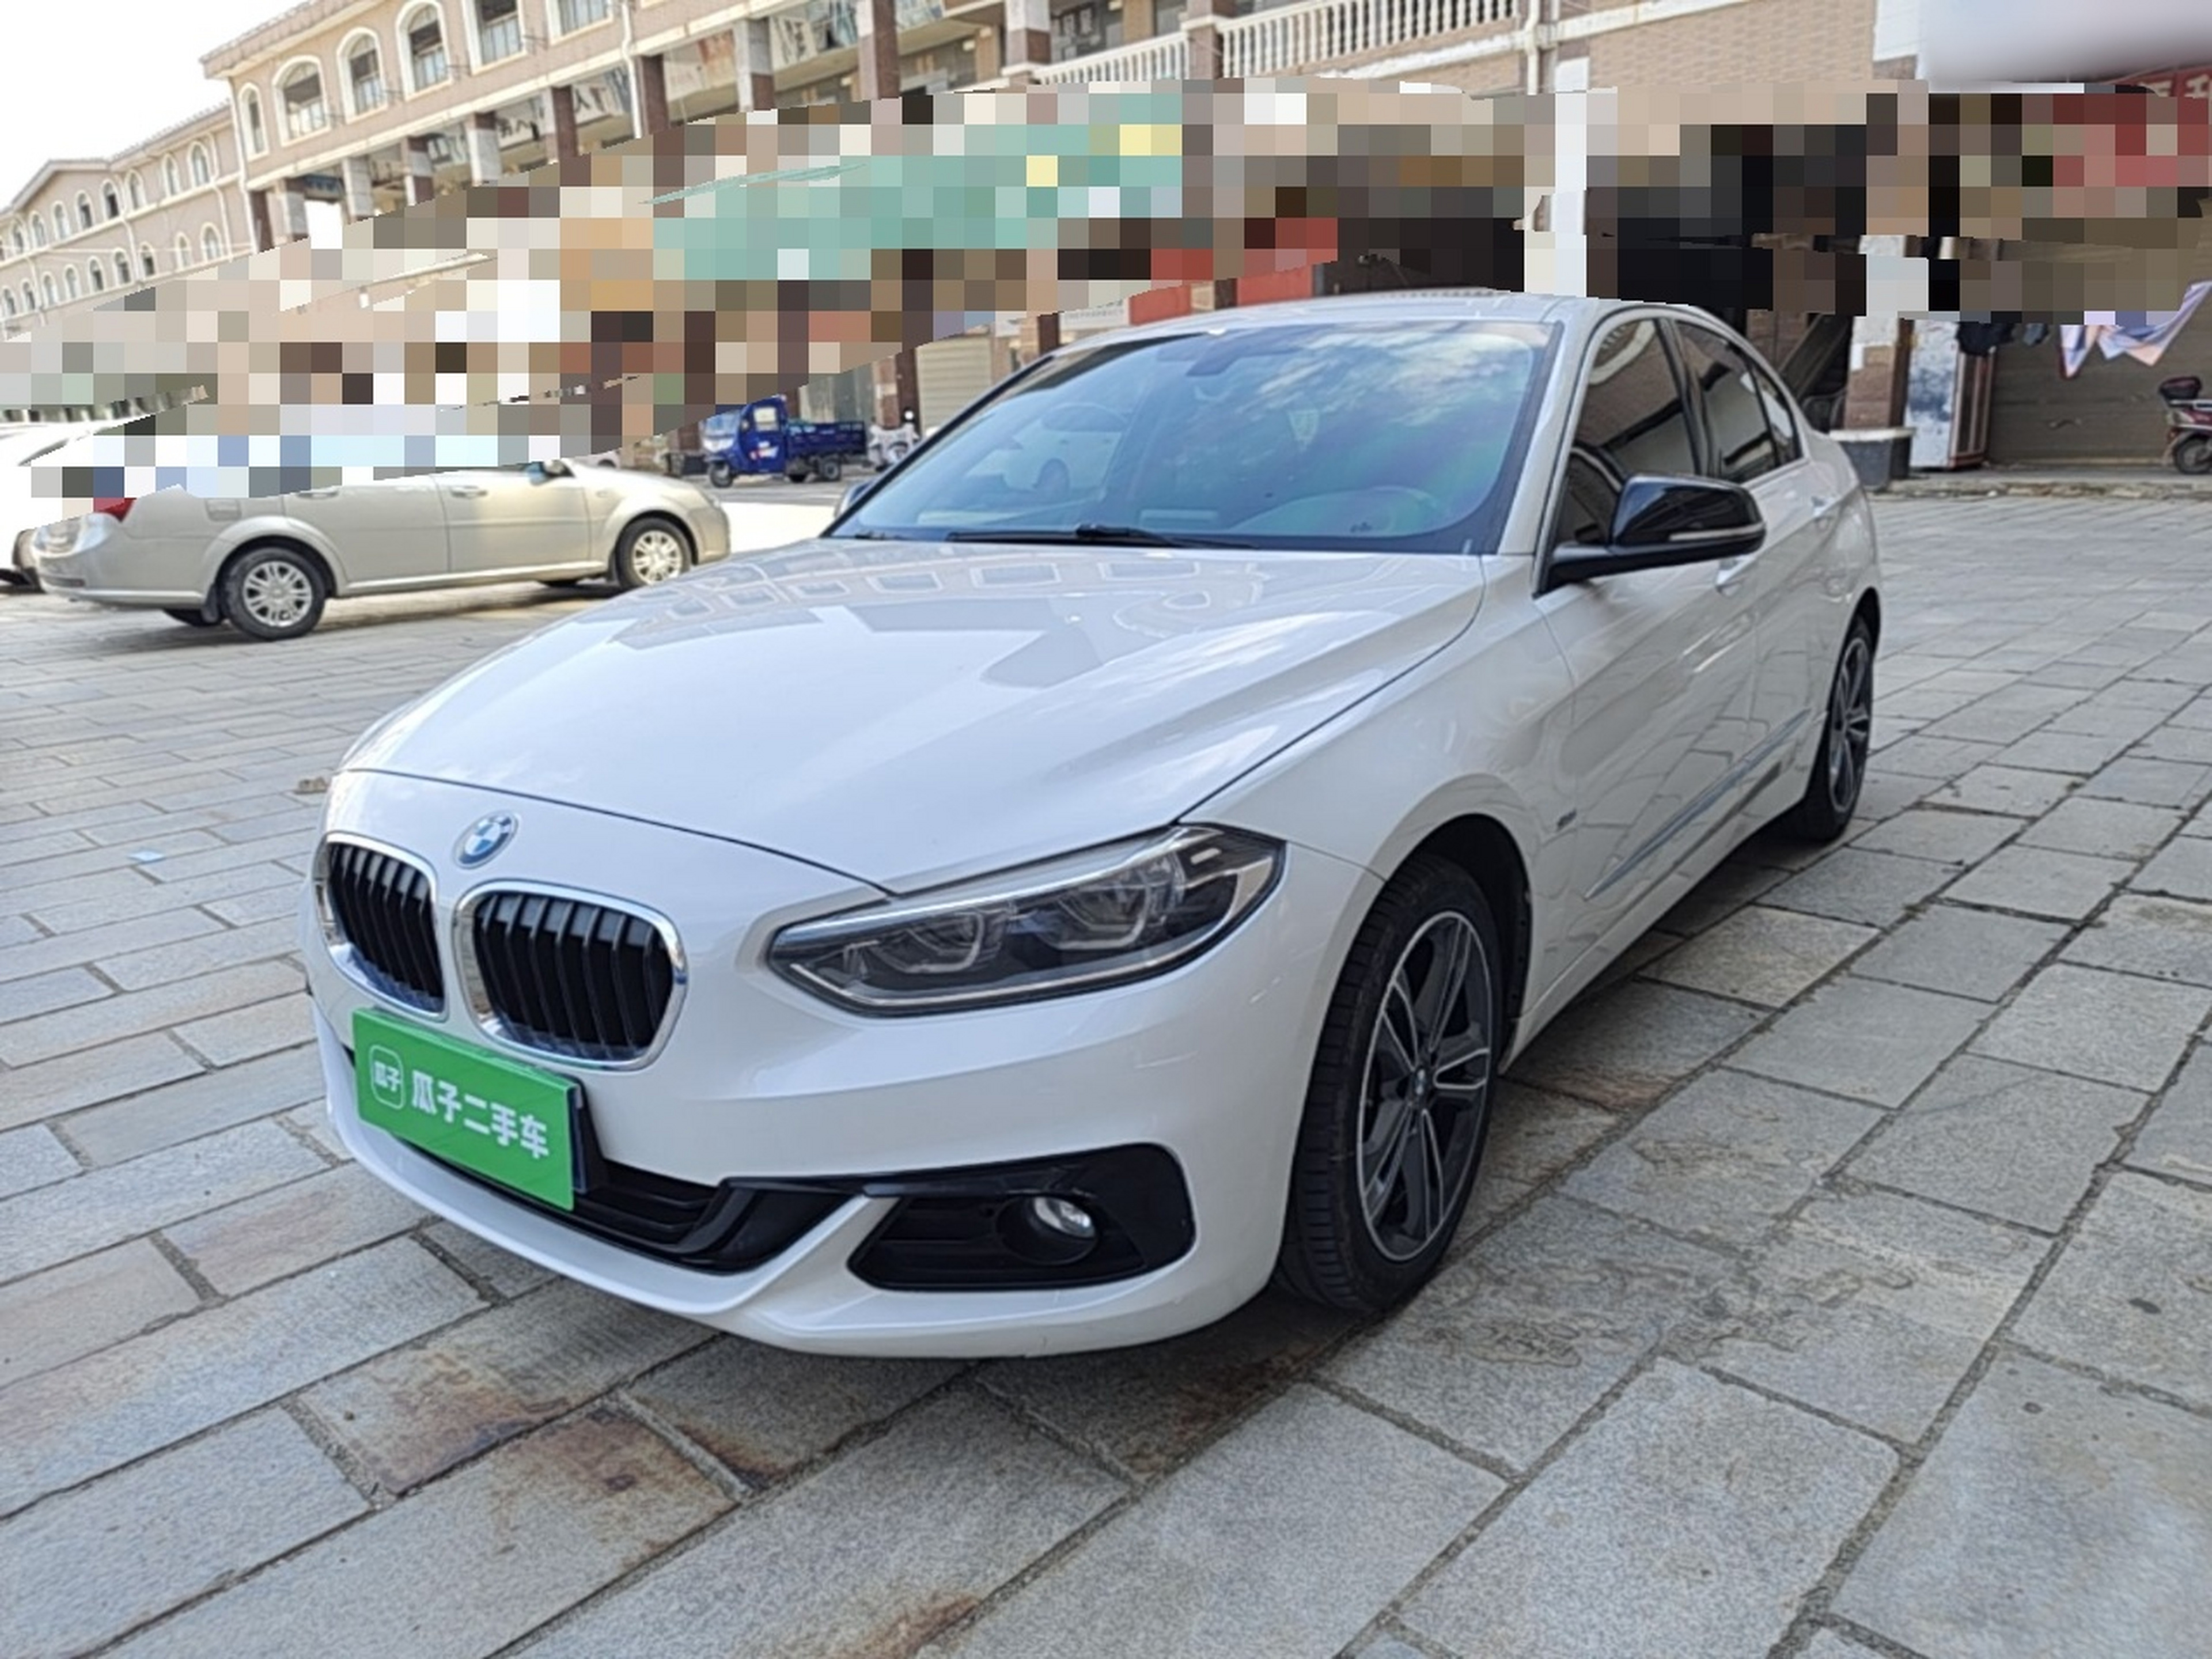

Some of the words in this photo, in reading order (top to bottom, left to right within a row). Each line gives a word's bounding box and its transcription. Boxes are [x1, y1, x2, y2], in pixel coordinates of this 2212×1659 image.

[411, 1069, 550, 1160] 瓜子二手车
